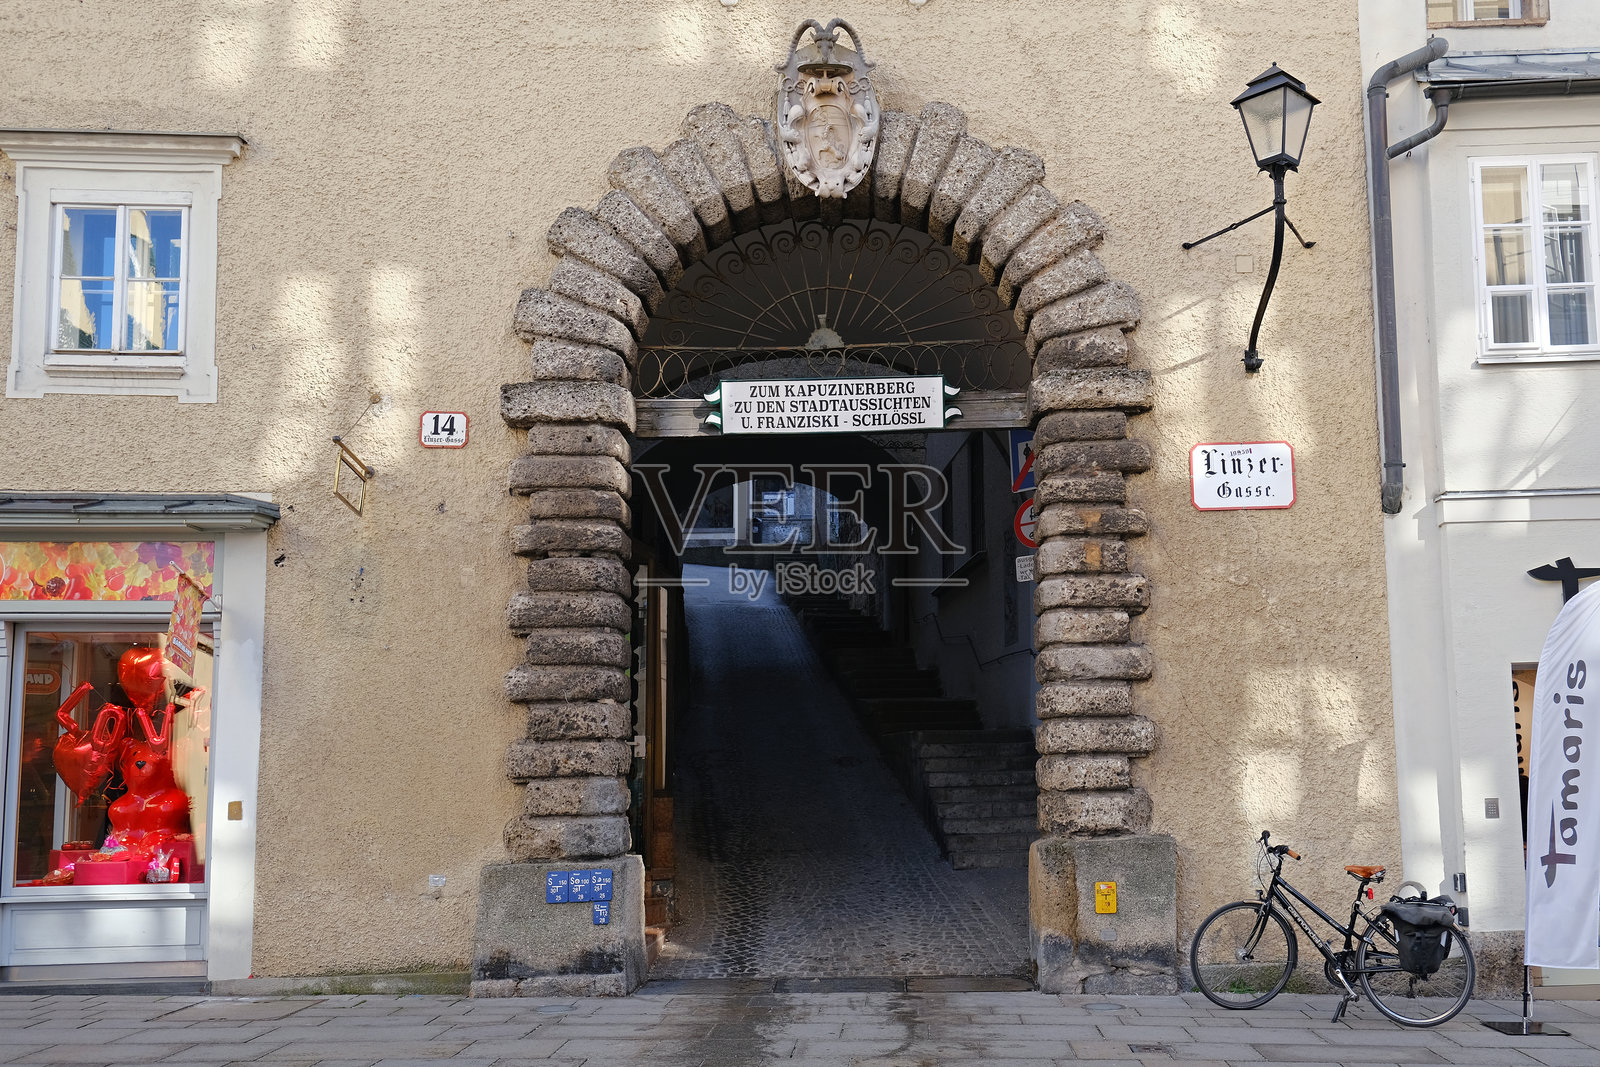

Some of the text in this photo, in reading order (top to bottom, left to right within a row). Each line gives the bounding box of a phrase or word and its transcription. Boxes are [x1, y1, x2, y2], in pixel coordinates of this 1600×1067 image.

[749, 381, 916, 398] ZUM KAPUZINERBERG
[734, 396, 931, 413] ZU DEN STADTAUSSICHTEN
[432, 414, 456, 435] 14
[741, 416, 753, 429] U.
[757, 415, 839, 428] FRANZISKI
[852, 409, 926, 427] SCHLÖSSL
[1540, 659, 1587, 889] tamaris
